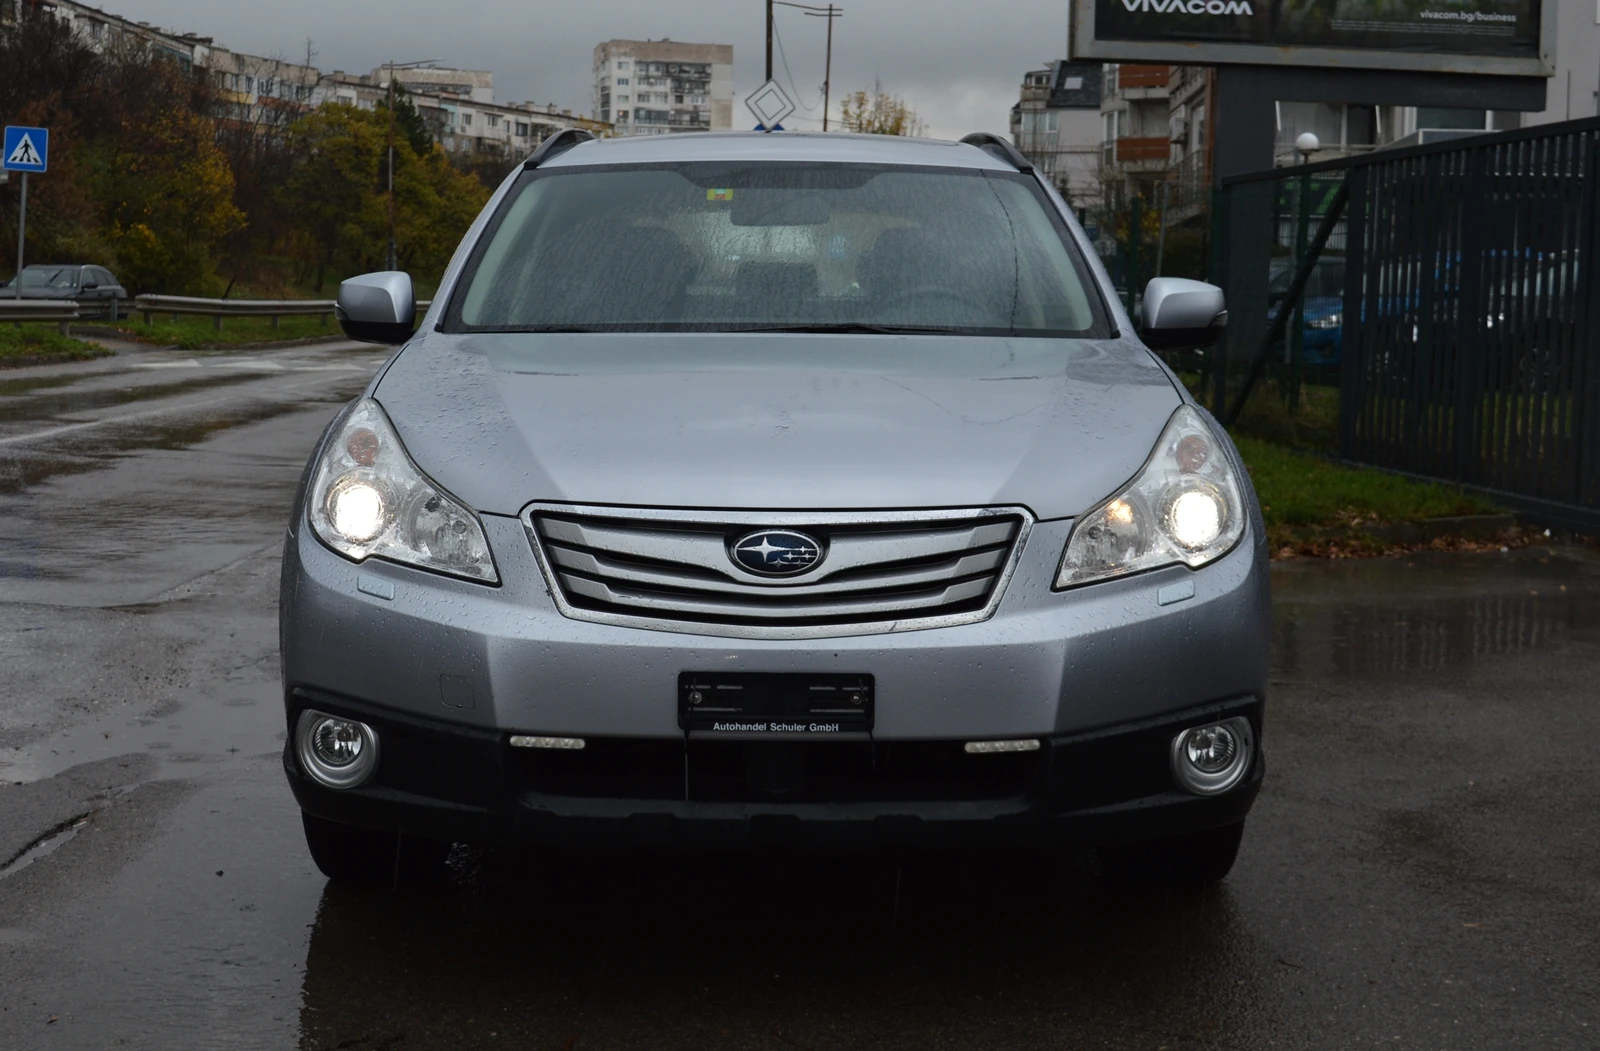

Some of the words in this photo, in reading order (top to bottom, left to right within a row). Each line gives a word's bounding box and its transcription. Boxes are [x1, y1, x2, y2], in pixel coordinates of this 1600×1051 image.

[1122, 0, 1253, 16] VIVACOM
[1420, 10, 1517, 23] vivacom.bg/business
[713, 722, 767, 731] Autohandel
[770, 722, 806, 732] Schuler
[809, 723, 839, 732] GmbH
